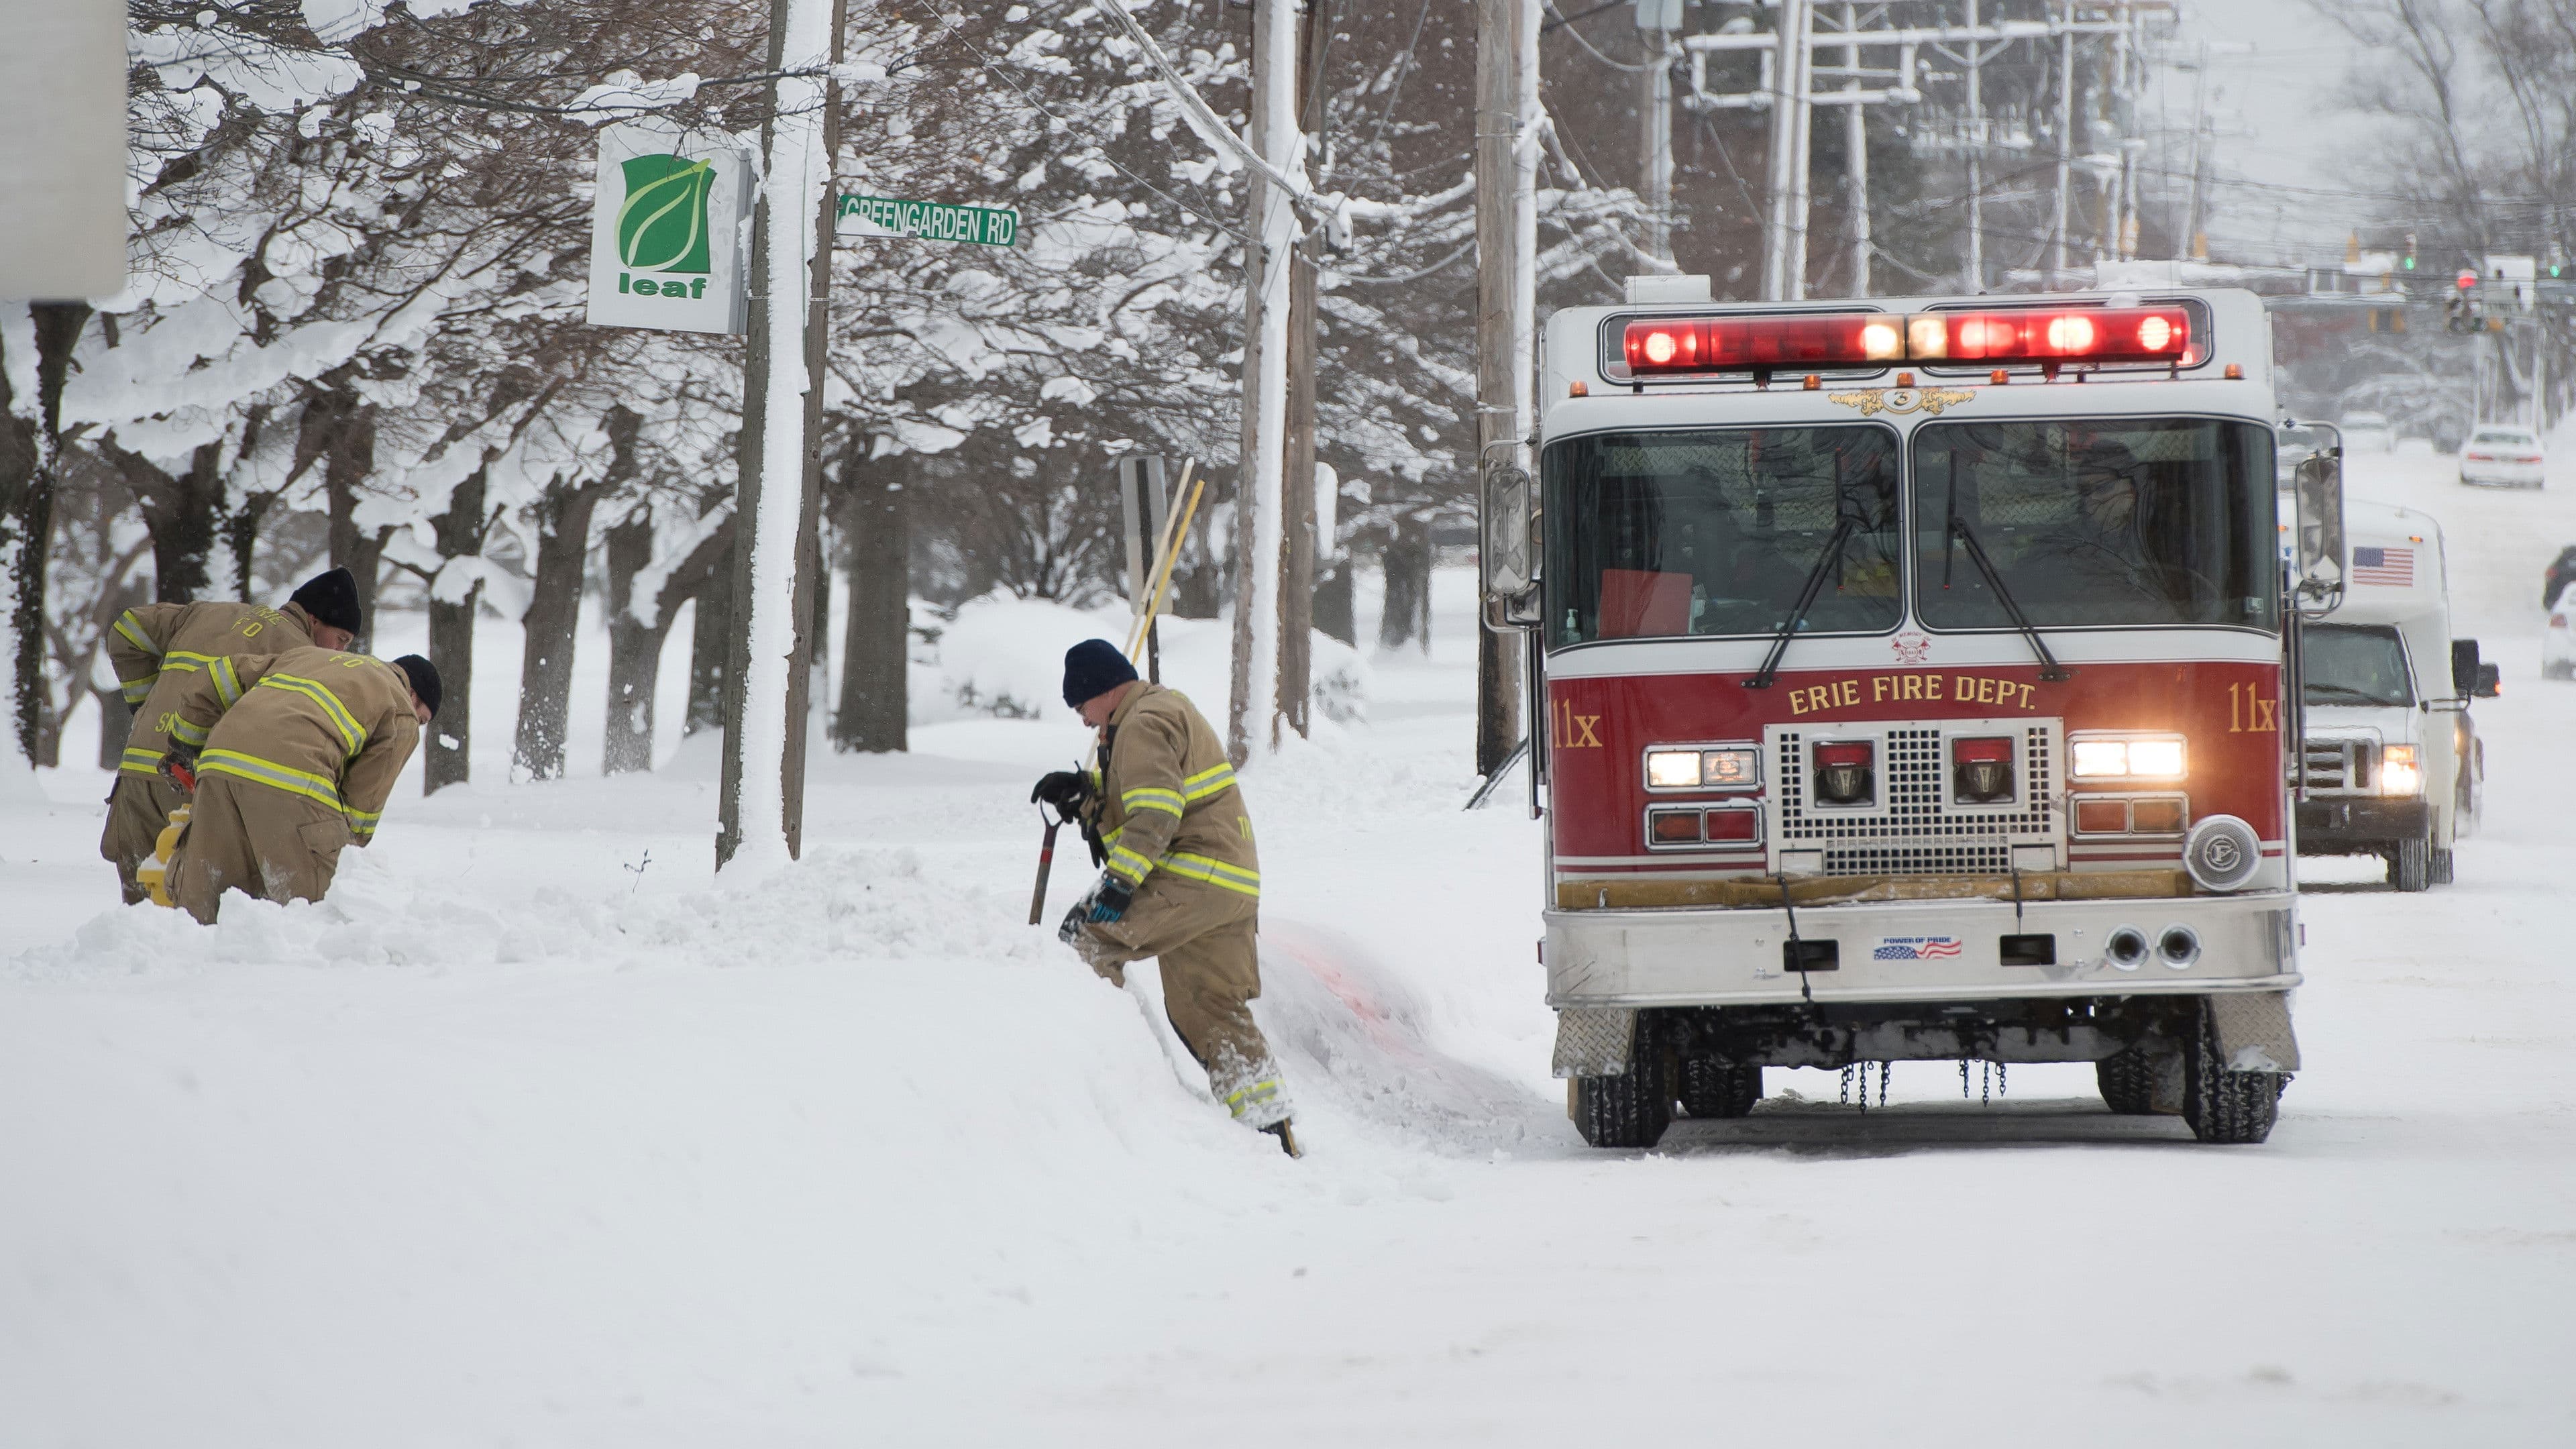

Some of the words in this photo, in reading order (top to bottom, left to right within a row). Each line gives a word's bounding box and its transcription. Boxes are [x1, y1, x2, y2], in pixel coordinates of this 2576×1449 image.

[987, 211, 1013, 245] RD
[619, 272, 707, 299] leaf
[1894, 391, 1912, 406] 3
[1788, 679, 1861, 716] ERIE
[1873, 674, 1944, 702] FIRE
[1955, 675, 2036, 710] DEPT.
